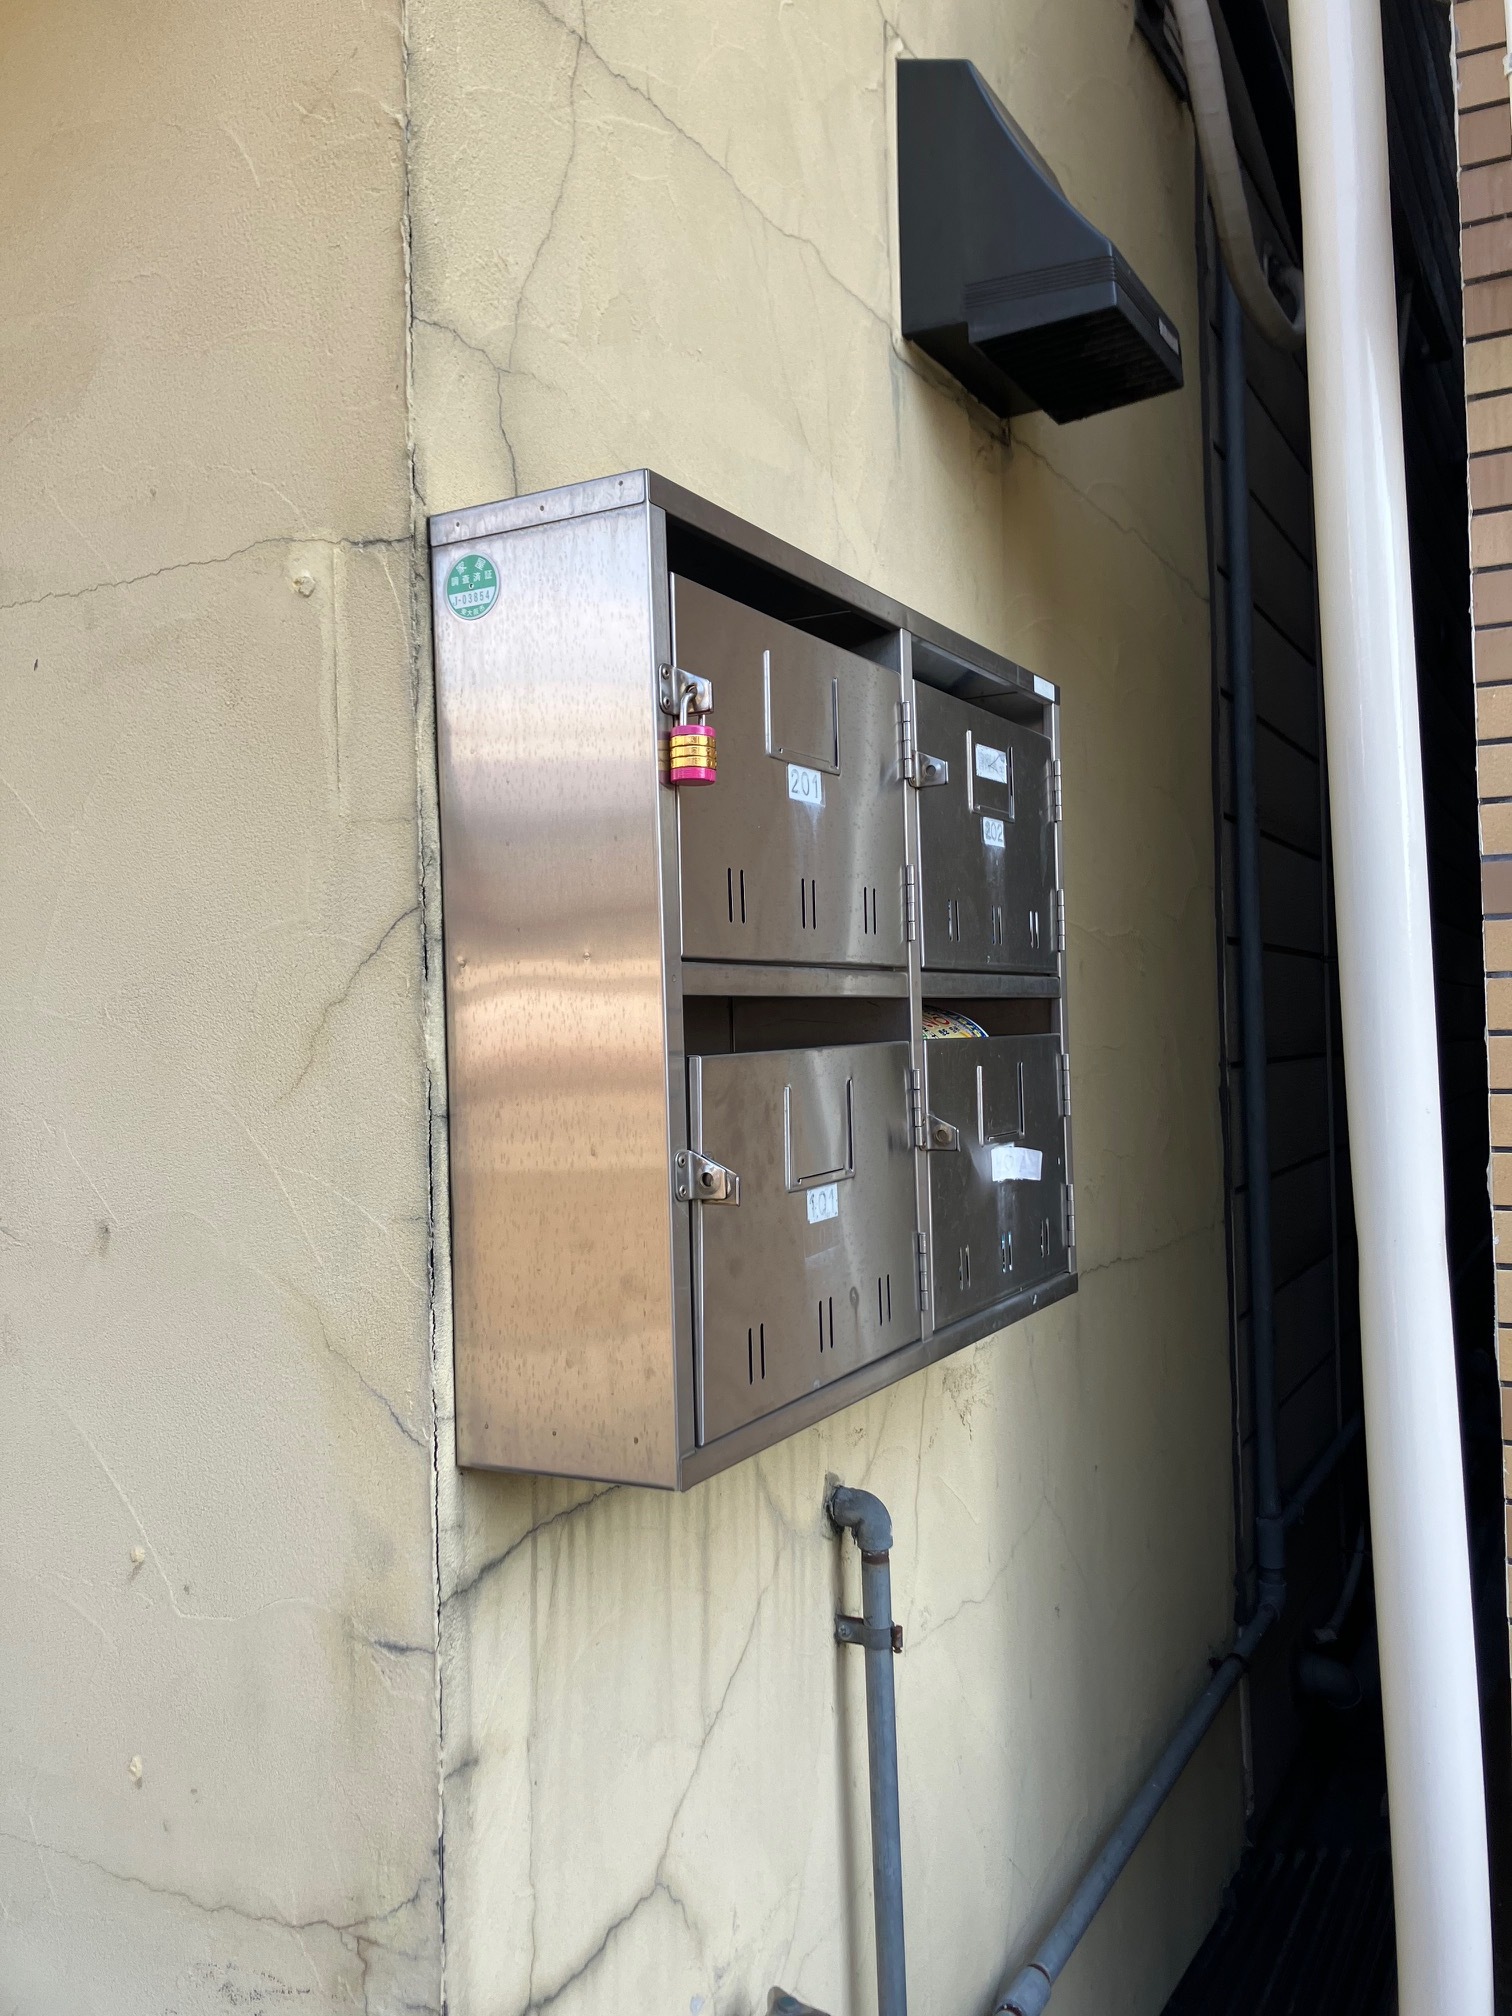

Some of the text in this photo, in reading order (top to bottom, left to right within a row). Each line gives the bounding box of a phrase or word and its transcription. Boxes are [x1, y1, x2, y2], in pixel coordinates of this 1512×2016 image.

[452, 590, 490, 606] J-03854
[790, 768, 819, 799] 201
[985, 820, 1003, 843] 202
[809, 1188, 835, 1218] 101
